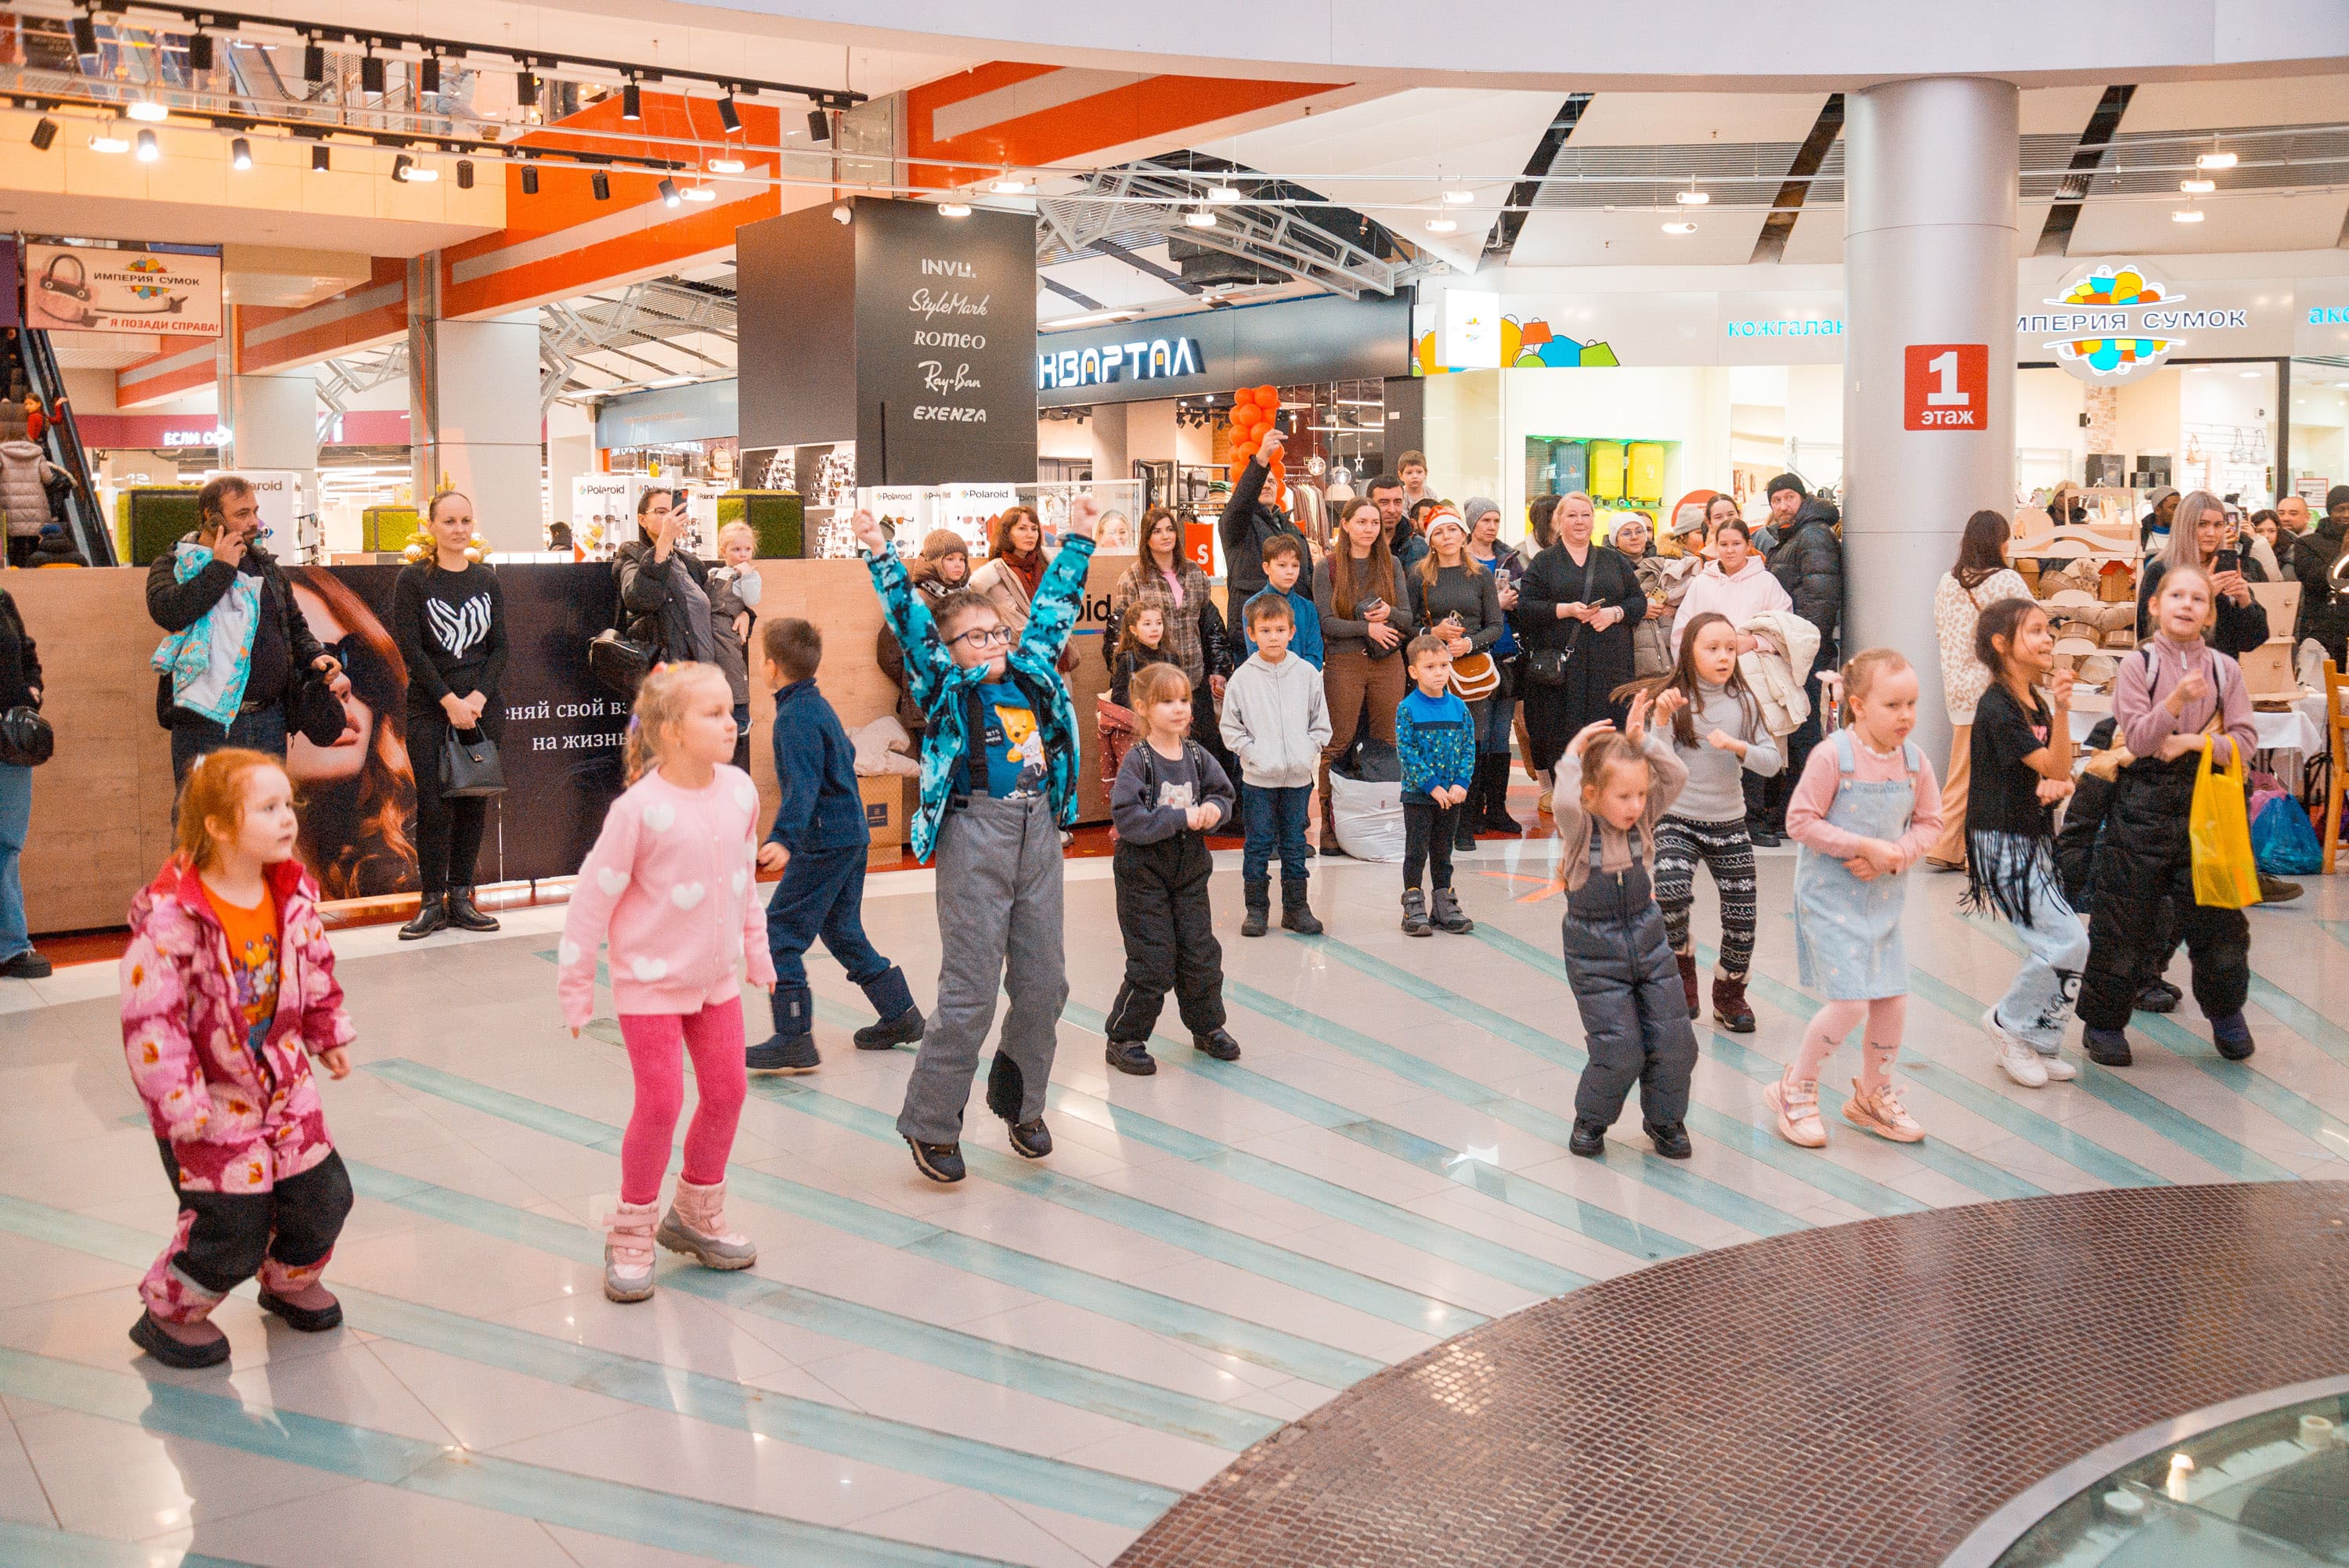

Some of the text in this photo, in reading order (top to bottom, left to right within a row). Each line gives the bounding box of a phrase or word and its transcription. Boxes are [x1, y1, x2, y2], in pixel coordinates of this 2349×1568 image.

[93, 272, 200, 286] ИМПЕРИЯ СУМОК
[908, 288, 990, 321] StyleMark
[121, 319, 169, 330] ПОЗАДИ
[171, 322, 218, 332] СПРАВА!
[2143, 310, 2248, 330] СУМОК
[1039, 337, 1196, 390] КВАРТАЛ
[1927, 351, 1969, 406] 1
[913, 406, 987, 423] EXENZA
[1921, 409, 1974, 424] этаж
[587, 485, 625, 495] Polaroid
[969, 490, 1009, 499] Polaroid
[506, 701, 550, 720] няй
[556, 697, 604, 717] свой
[532, 735, 557, 751] на
